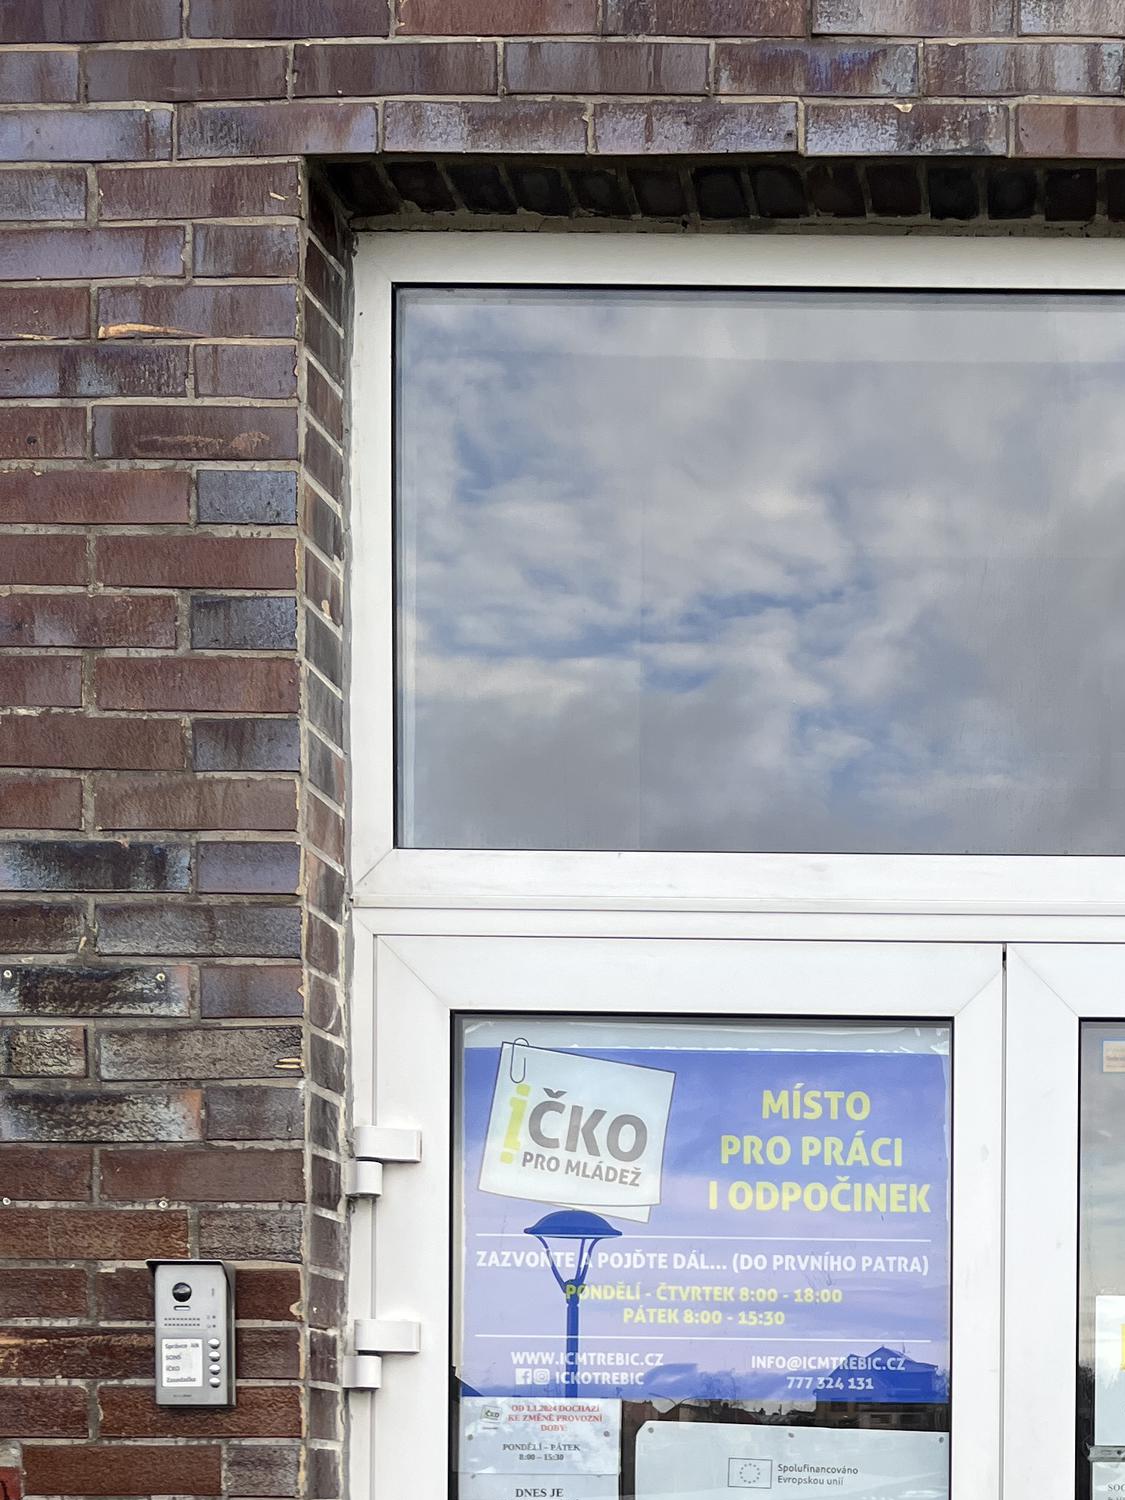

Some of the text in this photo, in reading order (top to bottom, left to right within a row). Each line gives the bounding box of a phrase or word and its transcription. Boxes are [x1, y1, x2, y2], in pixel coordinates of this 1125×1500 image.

[761, 1083, 871, 1121] MÍSTO
[720, 1130, 903, 1167] PRO PRÁCI
[522, 1150, 642, 1187] PRO MLÁDEŽ
[709, 1176, 932, 1213] I ODPOČINEK
[597, 1249, 669, 1269] POJĎTE
[672, 1248, 727, 1270] DÁL...
[732, 1253, 768, 1273] (DO
[772, 1252, 857, 1272] PRVNÍHO
[861, 1255, 930, 1276] PATRA)
[564, 1281, 642, 1301] PONDĚLÍ
[656, 1282, 735, 1301] ČTVRTEK
[738, 1286, 778, 1303] 8:00
[793, 1287, 843, 1303] 18:00
[623, 1305, 679, 1324] PÁTEK
[683, 1309, 723, 1325] 8:00
[737, 1311, 786, 1326] 15:30
[510, 1351, 665, 1366] WWW.ICMTREBIC.CZ
[751, 1354, 906, 1371] INFO@ICMTREBIC.CZ
[555, 1371, 645, 1385] ICKOTREBIC
[786, 1376, 874, 1390] 777 324 131
[512, 1404, 525, 1412] OD
[508, 1413, 603, 1422] KE ZMĚNĚ PROVOZNÍ
[502, 1442, 542, 1451] PONDĚLÍ
[550, 1443, 581, 1452] PÁTEK
[519, 1453, 536, 1461] 8:00
[543, 1453, 565, 1461] 15:30
[777, 1463, 859, 1474] Spolufinancováno
[777, 1475, 844, 1486] Evropskou unií
[515, 1488, 564, 1498] DNES JE
